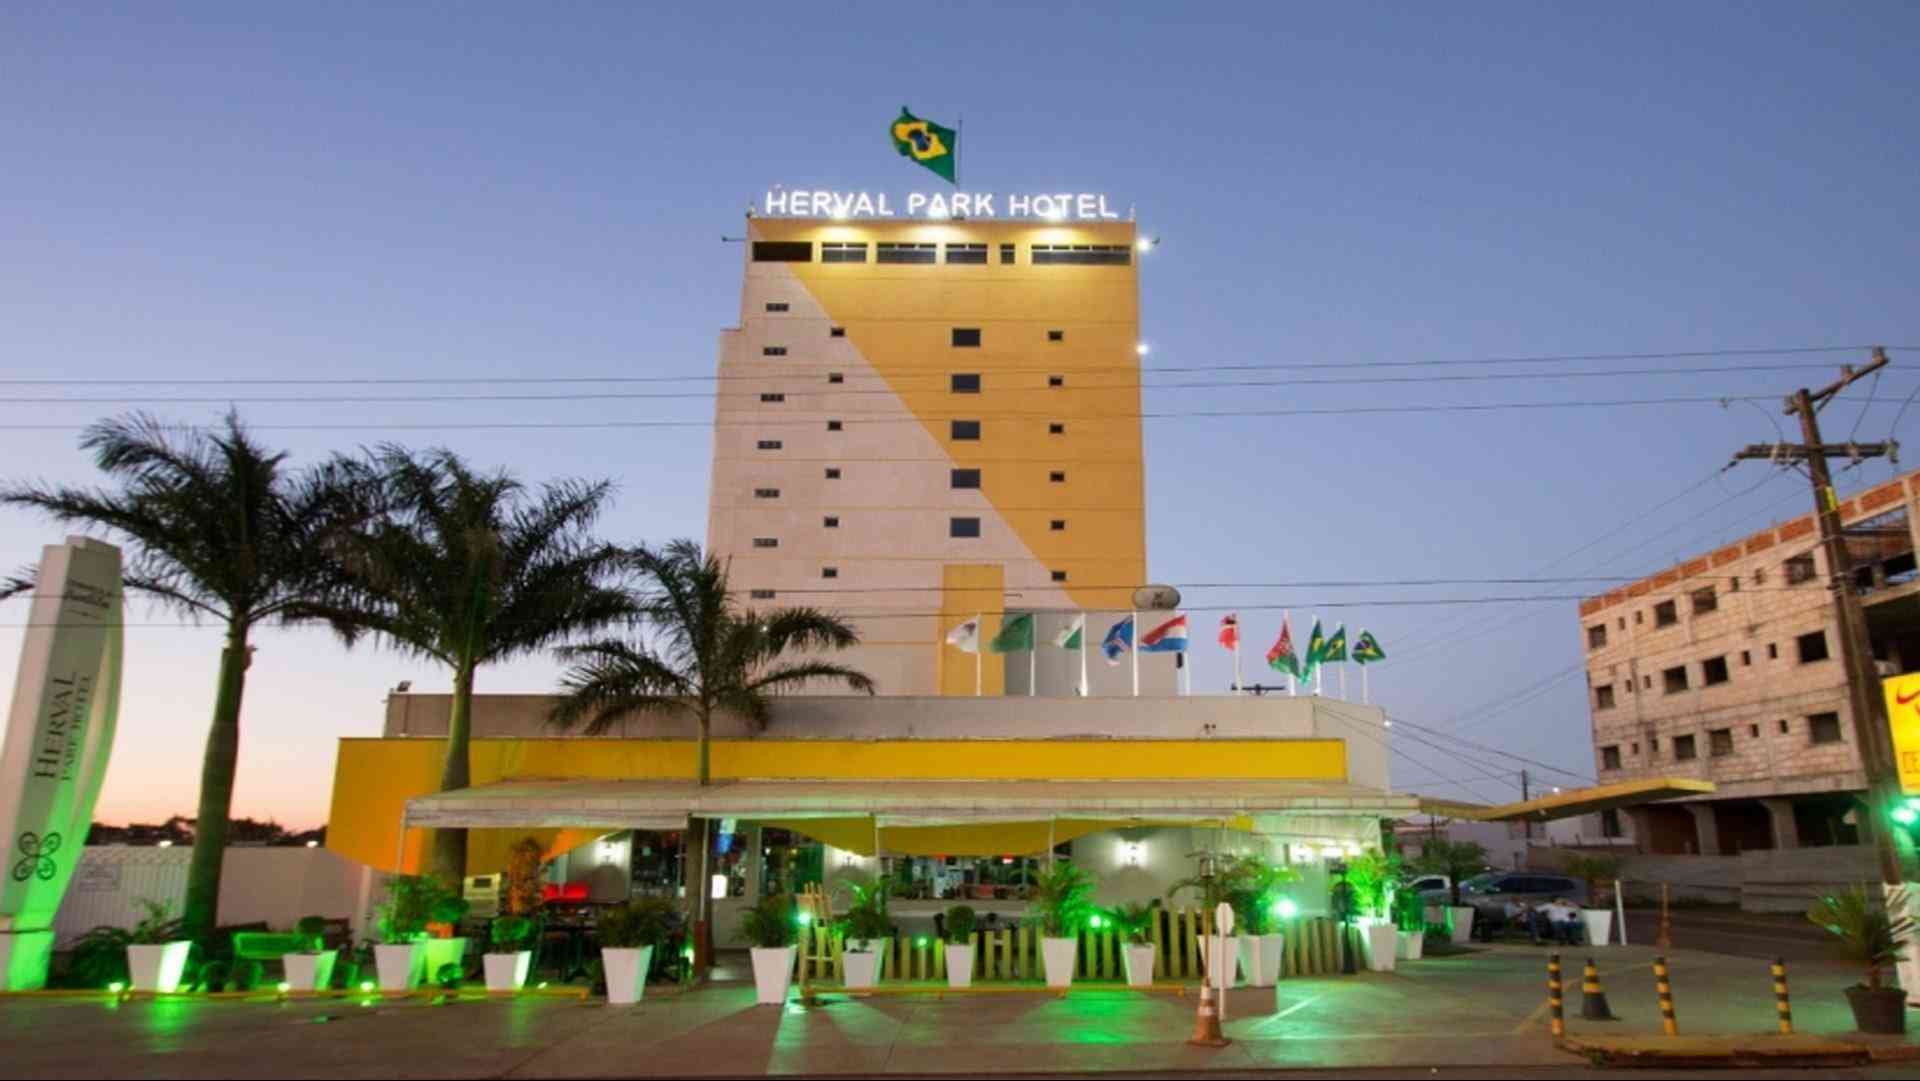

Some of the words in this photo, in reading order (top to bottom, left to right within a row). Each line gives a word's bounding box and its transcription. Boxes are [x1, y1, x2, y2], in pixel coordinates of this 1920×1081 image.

[764, 190, 895, 217] HERVAL
[907, 192, 995, 218] PARK
[1008, 193, 1119, 219] HOTEL
[34, 672, 76, 778] HERVAL
